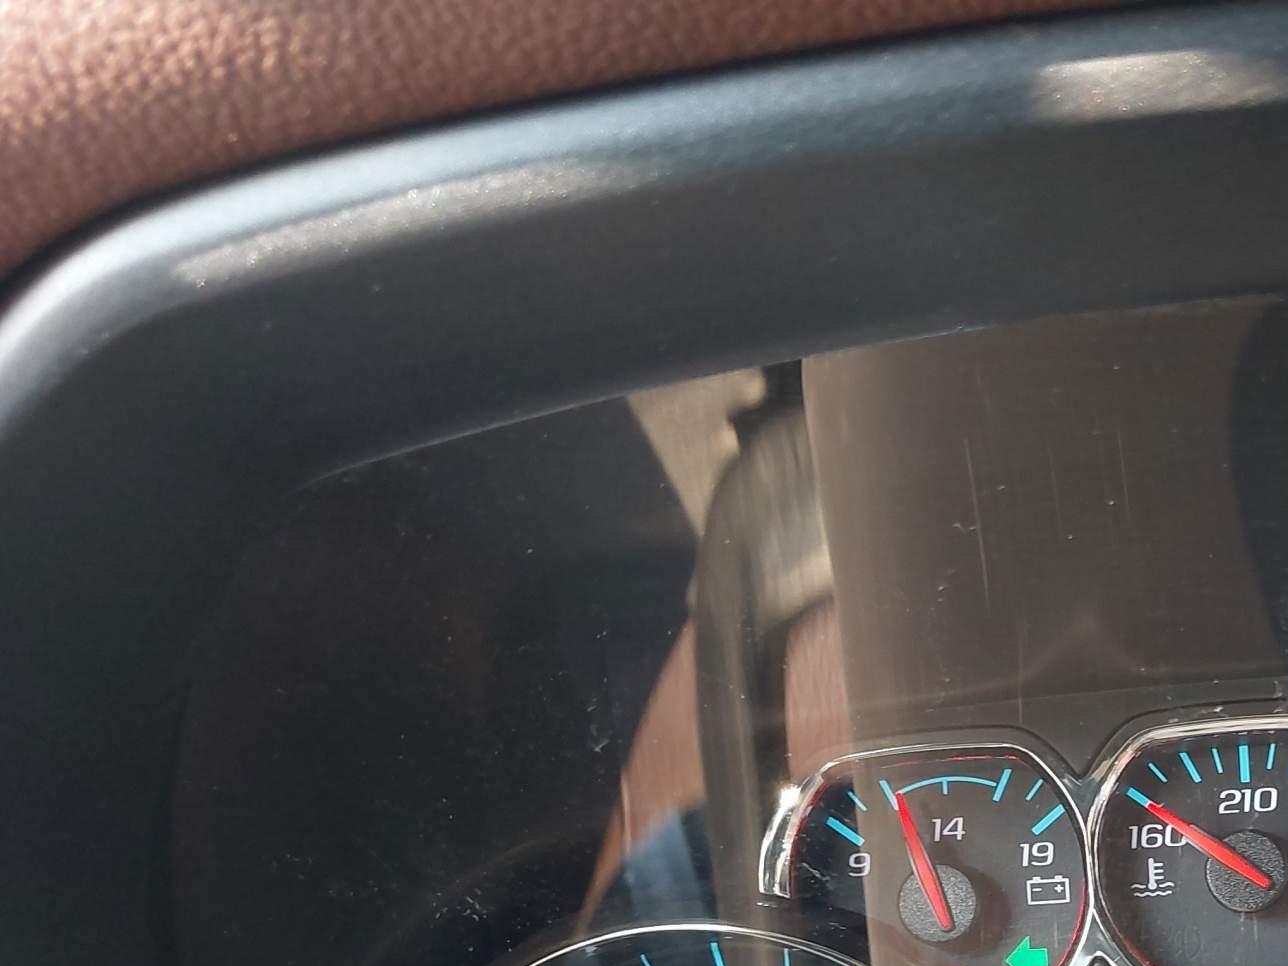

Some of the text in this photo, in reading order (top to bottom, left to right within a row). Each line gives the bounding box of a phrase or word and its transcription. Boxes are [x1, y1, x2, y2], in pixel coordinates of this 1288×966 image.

[1218, 787, 1279, 815] 210
[931, 816, 966, 841] 14
[1128, 823, 1188, 850] 160
[848, 852, 872, 877] 9
[1019, 841, 1054, 867] 19
